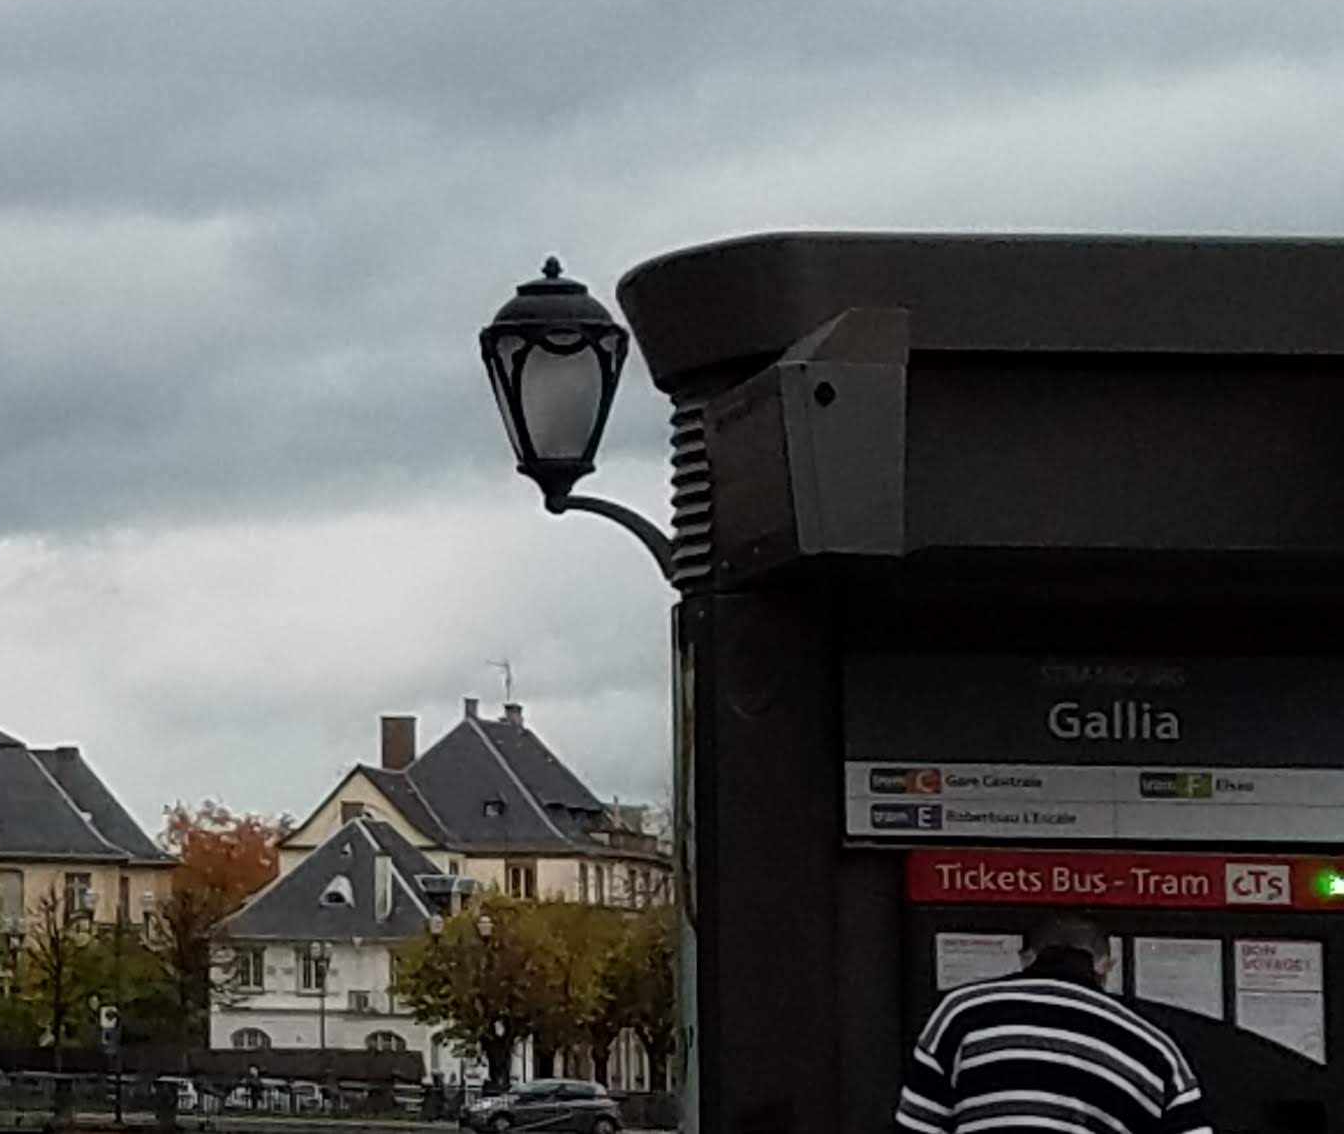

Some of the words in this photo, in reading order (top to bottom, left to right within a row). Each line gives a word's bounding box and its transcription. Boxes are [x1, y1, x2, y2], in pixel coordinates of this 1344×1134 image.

[1048, 700, 1180, 741] Gallia
[916, 773, 936, 793] C
[1187, 775, 1201, 797] F
[918, 807, 932, 828] E
[935, 862, 1043, 892] Tickets
[1051, 866, 1107, 894] Bus
[1130, 867, 1209, 897] Tram
